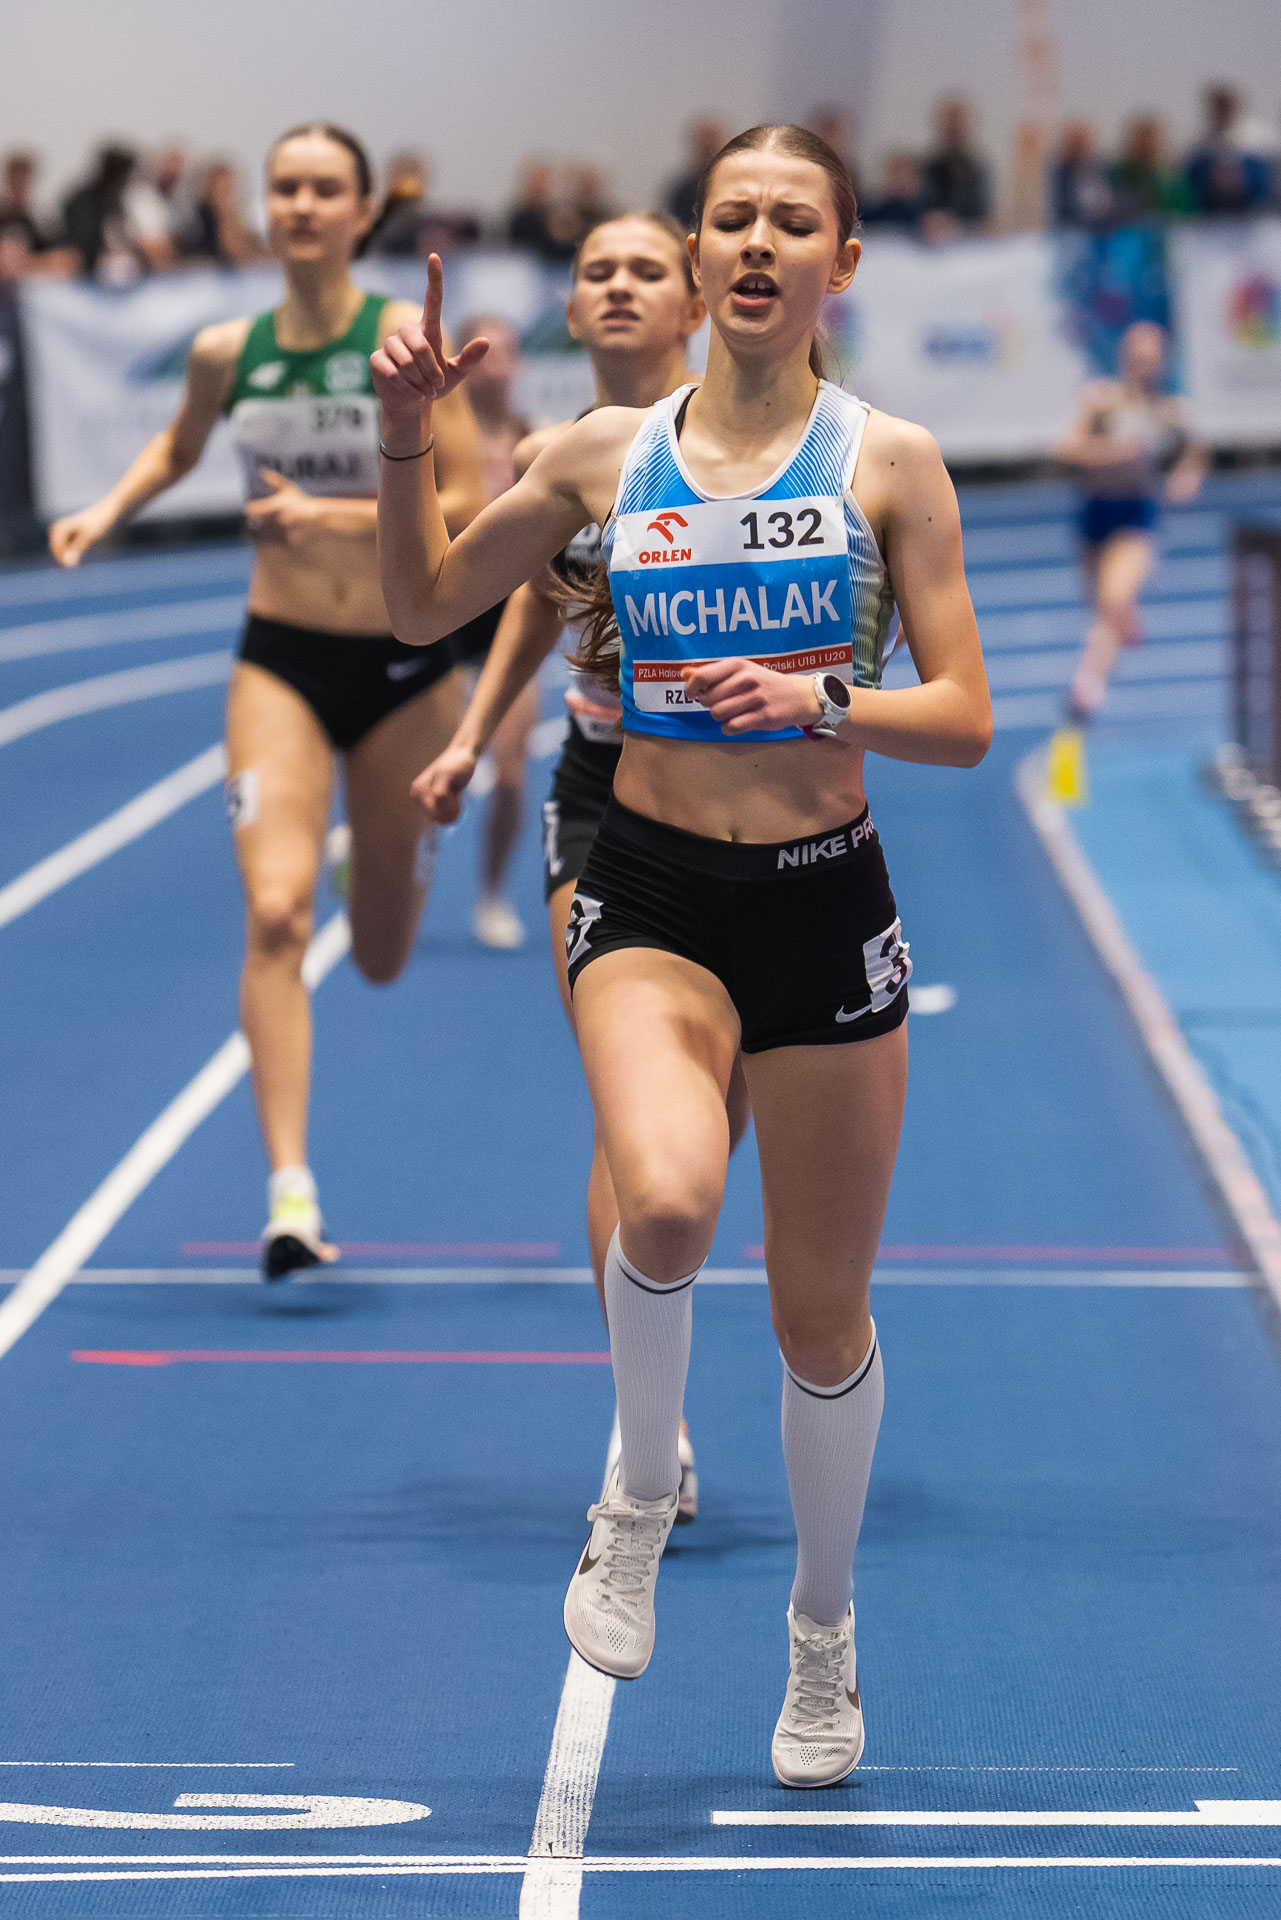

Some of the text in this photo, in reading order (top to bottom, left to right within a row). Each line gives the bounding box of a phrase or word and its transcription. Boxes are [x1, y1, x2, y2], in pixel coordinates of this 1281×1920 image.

[740, 508, 825, 550] 132
[638, 548, 692, 564] ORLEN
[624, 579, 841, 637] MICHALAK
[638, 668, 657, 679] PZLA
[659, 668, 682, 678] Halow
[798, 655, 816, 667] U18
[824, 650, 846, 662] U20
[777, 812, 874, 870] NIKE PR
[879, 931, 908, 996] 3
